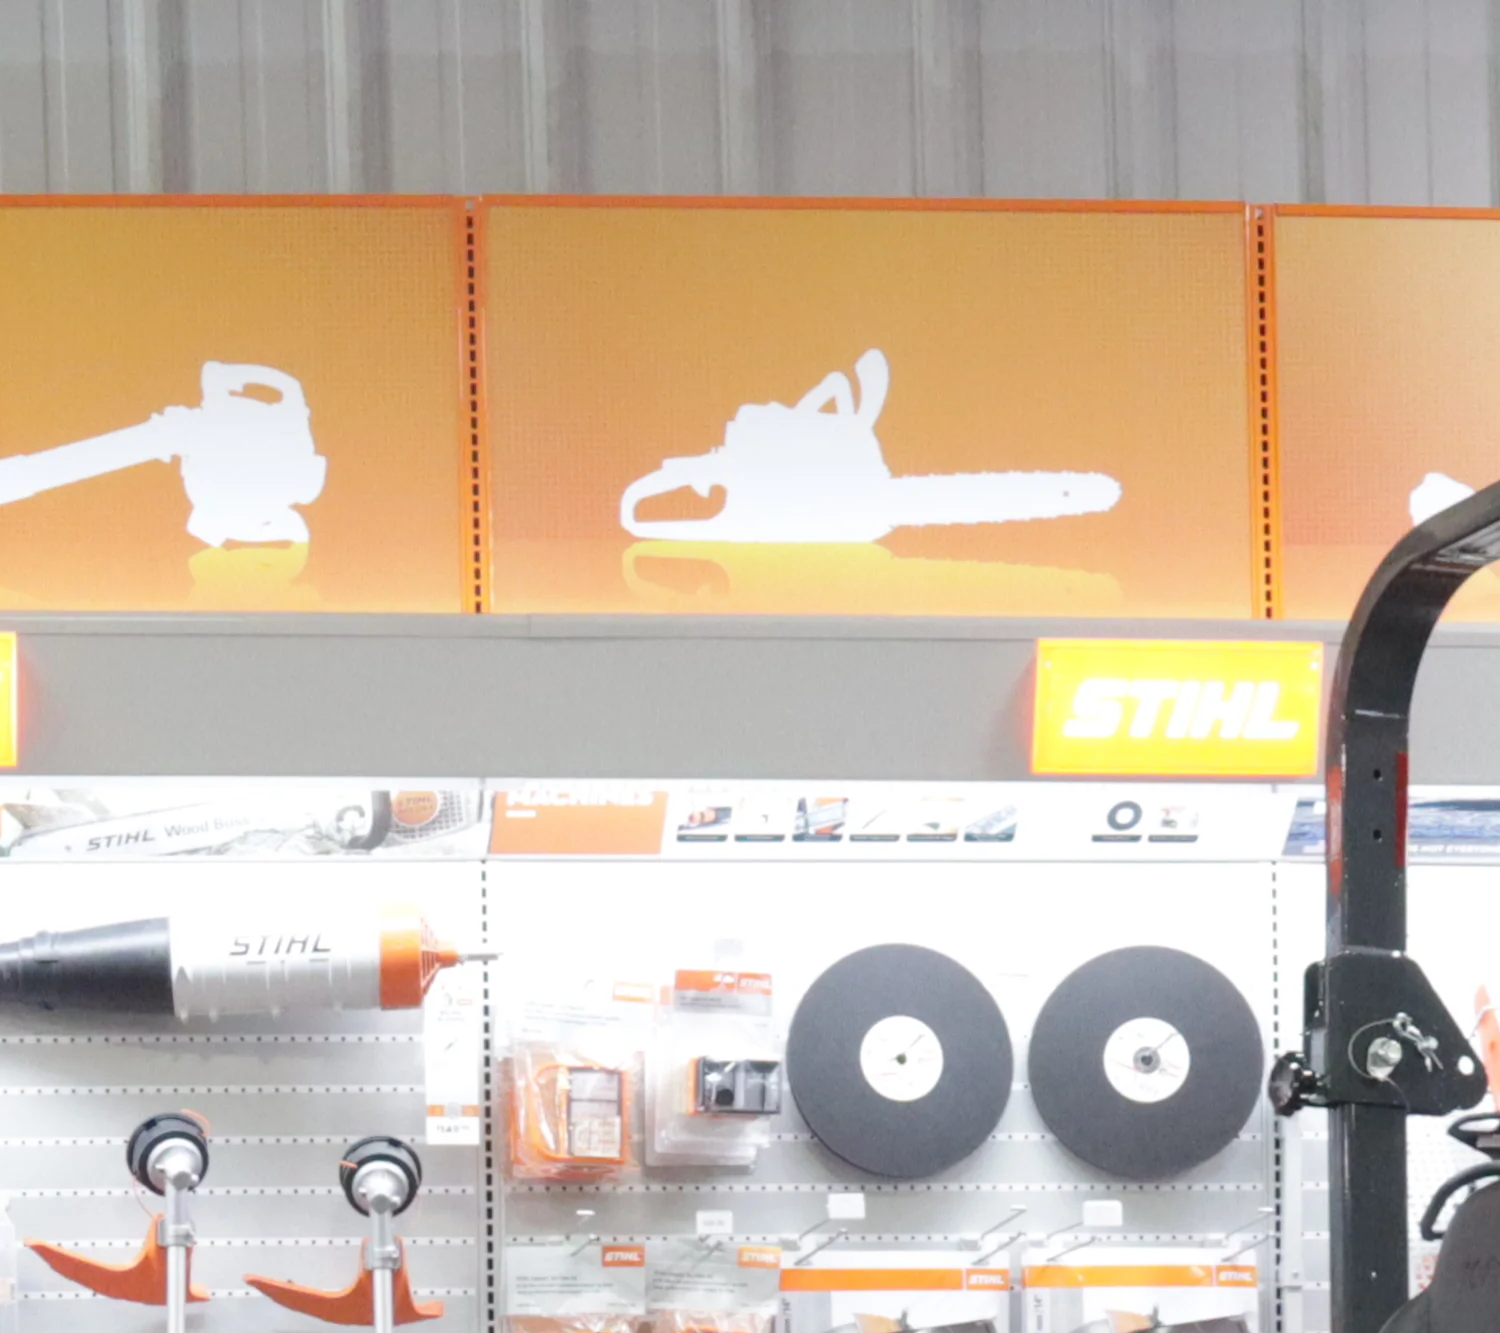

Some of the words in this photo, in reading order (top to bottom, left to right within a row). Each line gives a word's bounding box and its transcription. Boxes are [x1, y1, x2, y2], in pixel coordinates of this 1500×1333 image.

[1062, 679, 1299, 740] STIHL
[87, 828, 156, 851] STIHL
[164, 818, 210, 839] Wood
[229, 933, 333, 957] STIHL
[604, 1251, 642, 1262] STIHL
[968, 1274, 1006, 1285] STIHL
